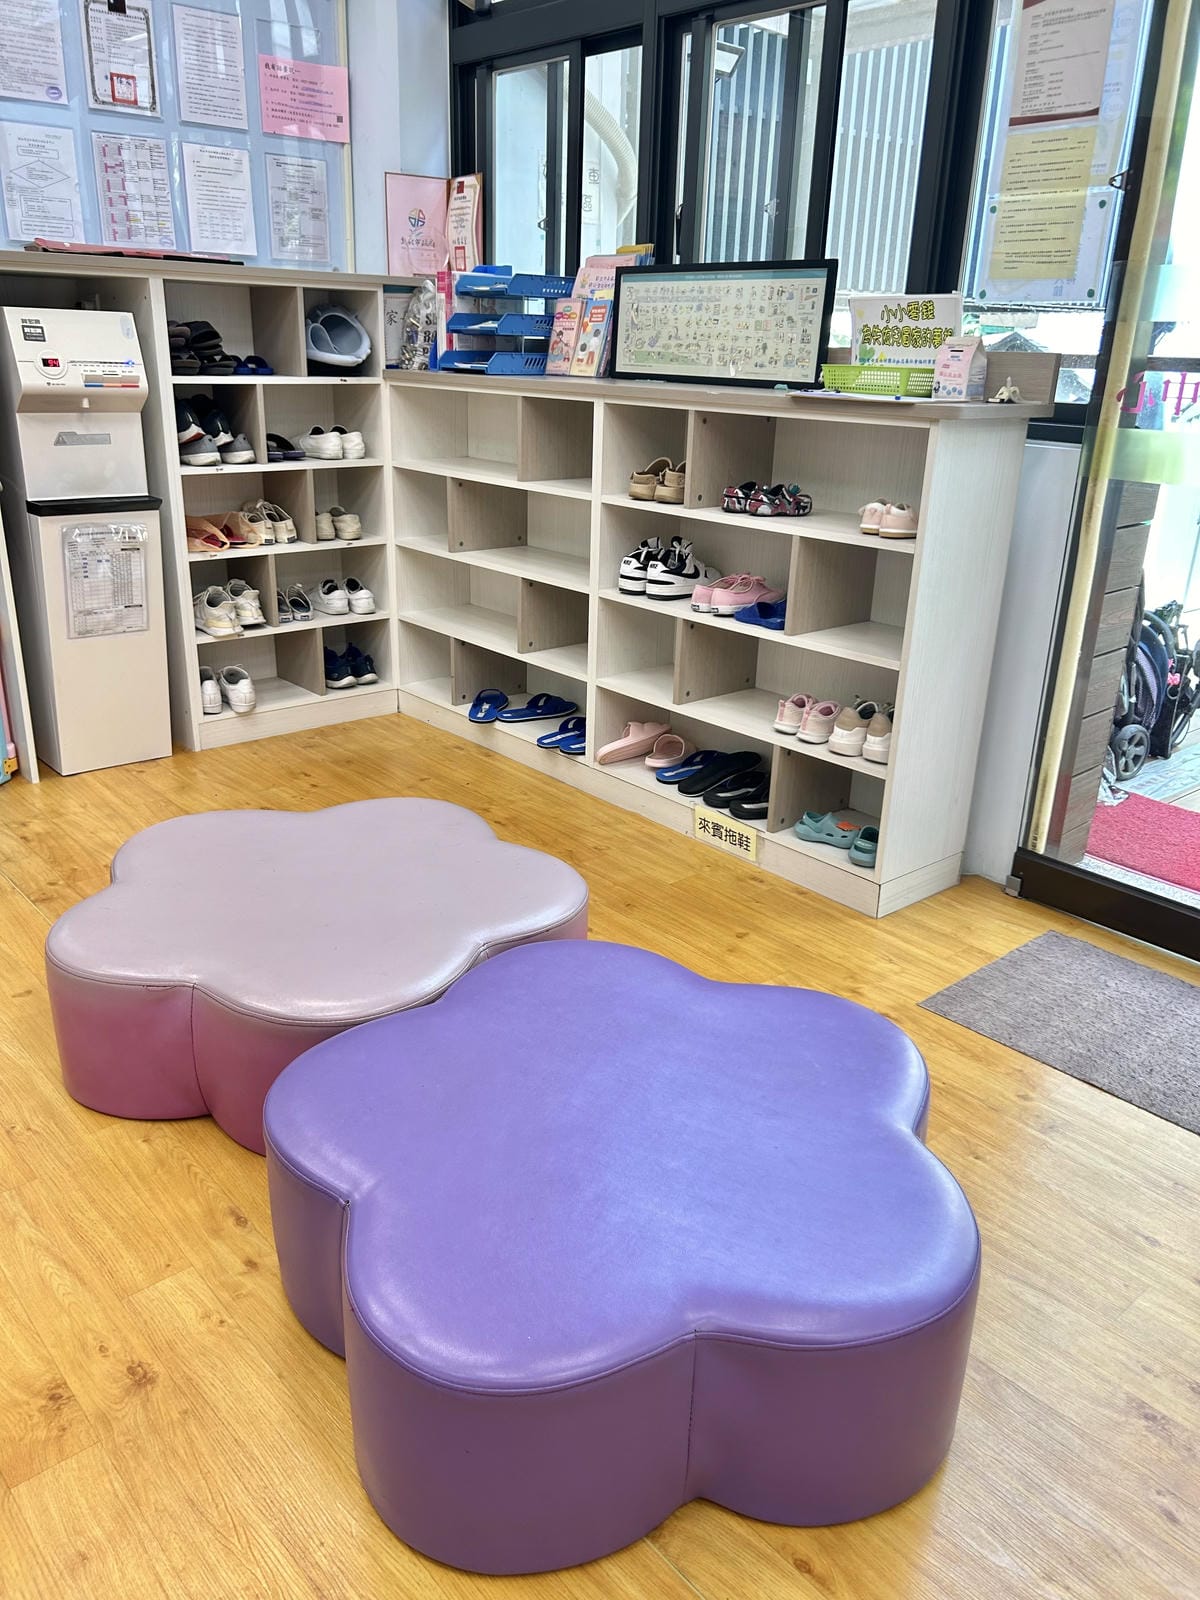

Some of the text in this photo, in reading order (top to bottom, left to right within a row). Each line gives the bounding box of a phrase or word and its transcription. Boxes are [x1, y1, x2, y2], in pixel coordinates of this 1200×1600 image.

[881, 299, 935, 323] 小小零錢
[698, 817, 751, 852] 來賓拖鞋
